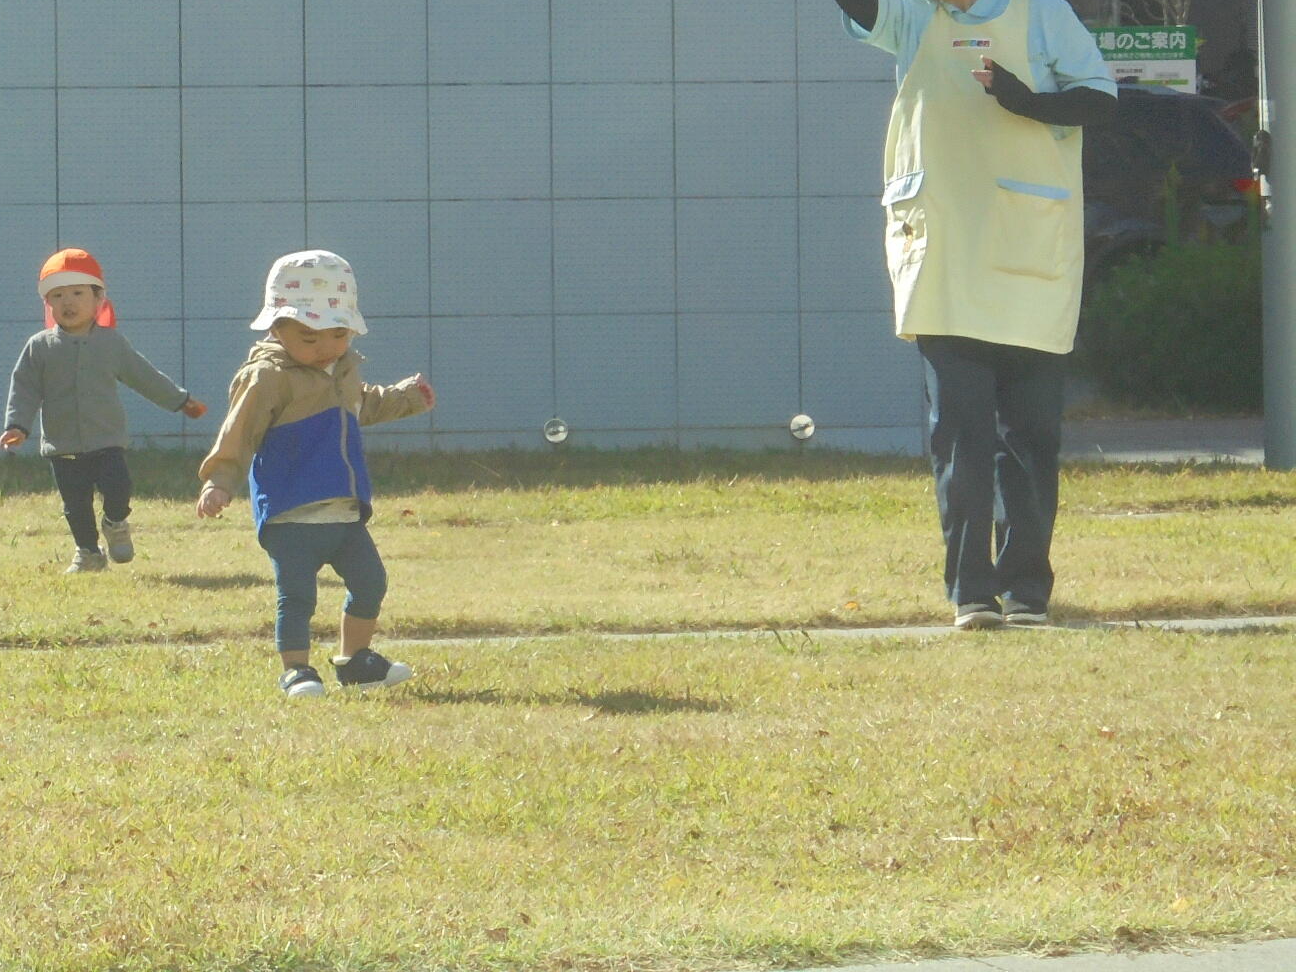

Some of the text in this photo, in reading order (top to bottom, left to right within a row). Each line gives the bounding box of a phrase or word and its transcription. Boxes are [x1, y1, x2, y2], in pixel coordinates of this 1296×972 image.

[1091, 31, 1186, 50] 場のご案内
